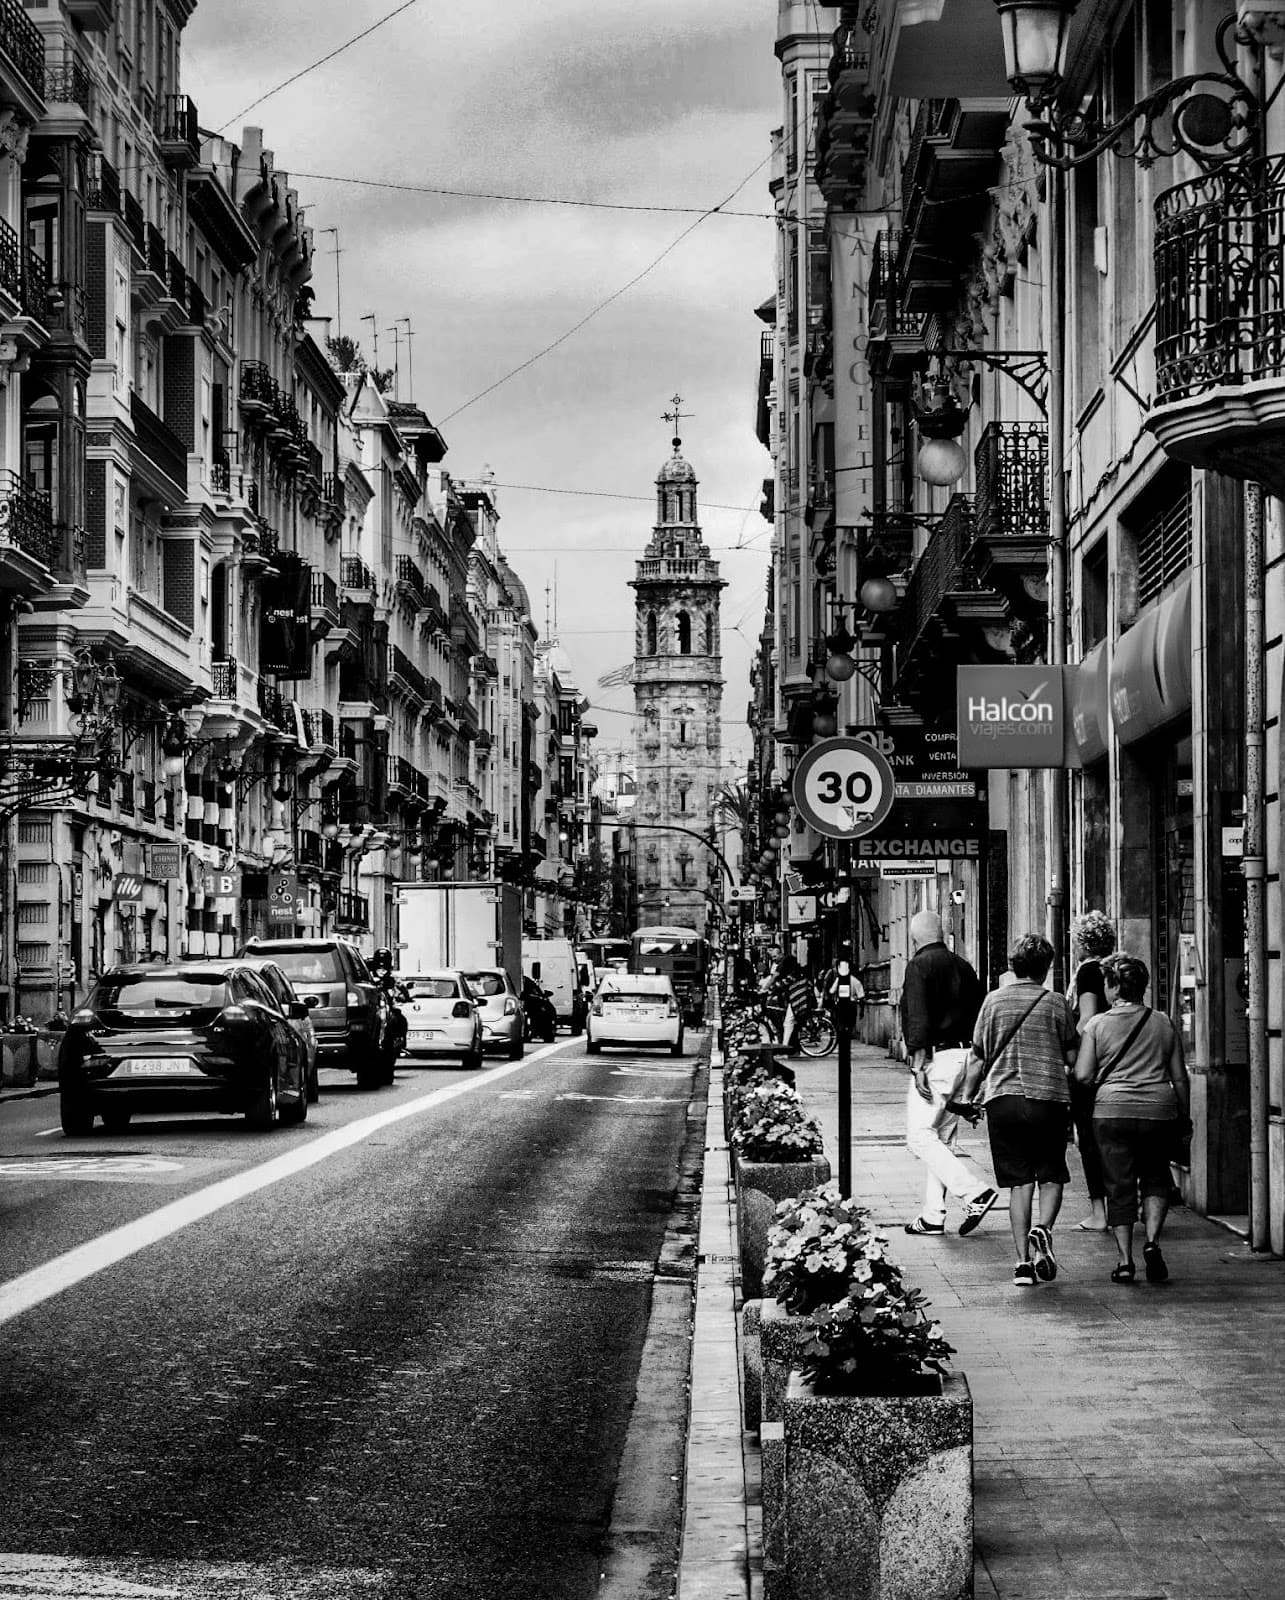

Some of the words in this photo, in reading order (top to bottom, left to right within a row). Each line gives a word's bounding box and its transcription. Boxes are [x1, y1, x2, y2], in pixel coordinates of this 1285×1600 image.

[273, 609, 294, 618] nest
[296, 615, 308, 624] st
[970, 722, 1053, 740] viajes.com
[925, 733, 958, 742] COMPR
[887, 754, 915, 766] ANK
[928, 751, 957, 761] VENTA
[817, 771, 872, 804] 30
[915, 784, 976, 796] DIAMANTES
[859, 839, 979, 856] EXCHANGE
[116, 877, 142, 899] illy
[271, 906, 294, 916] nest
